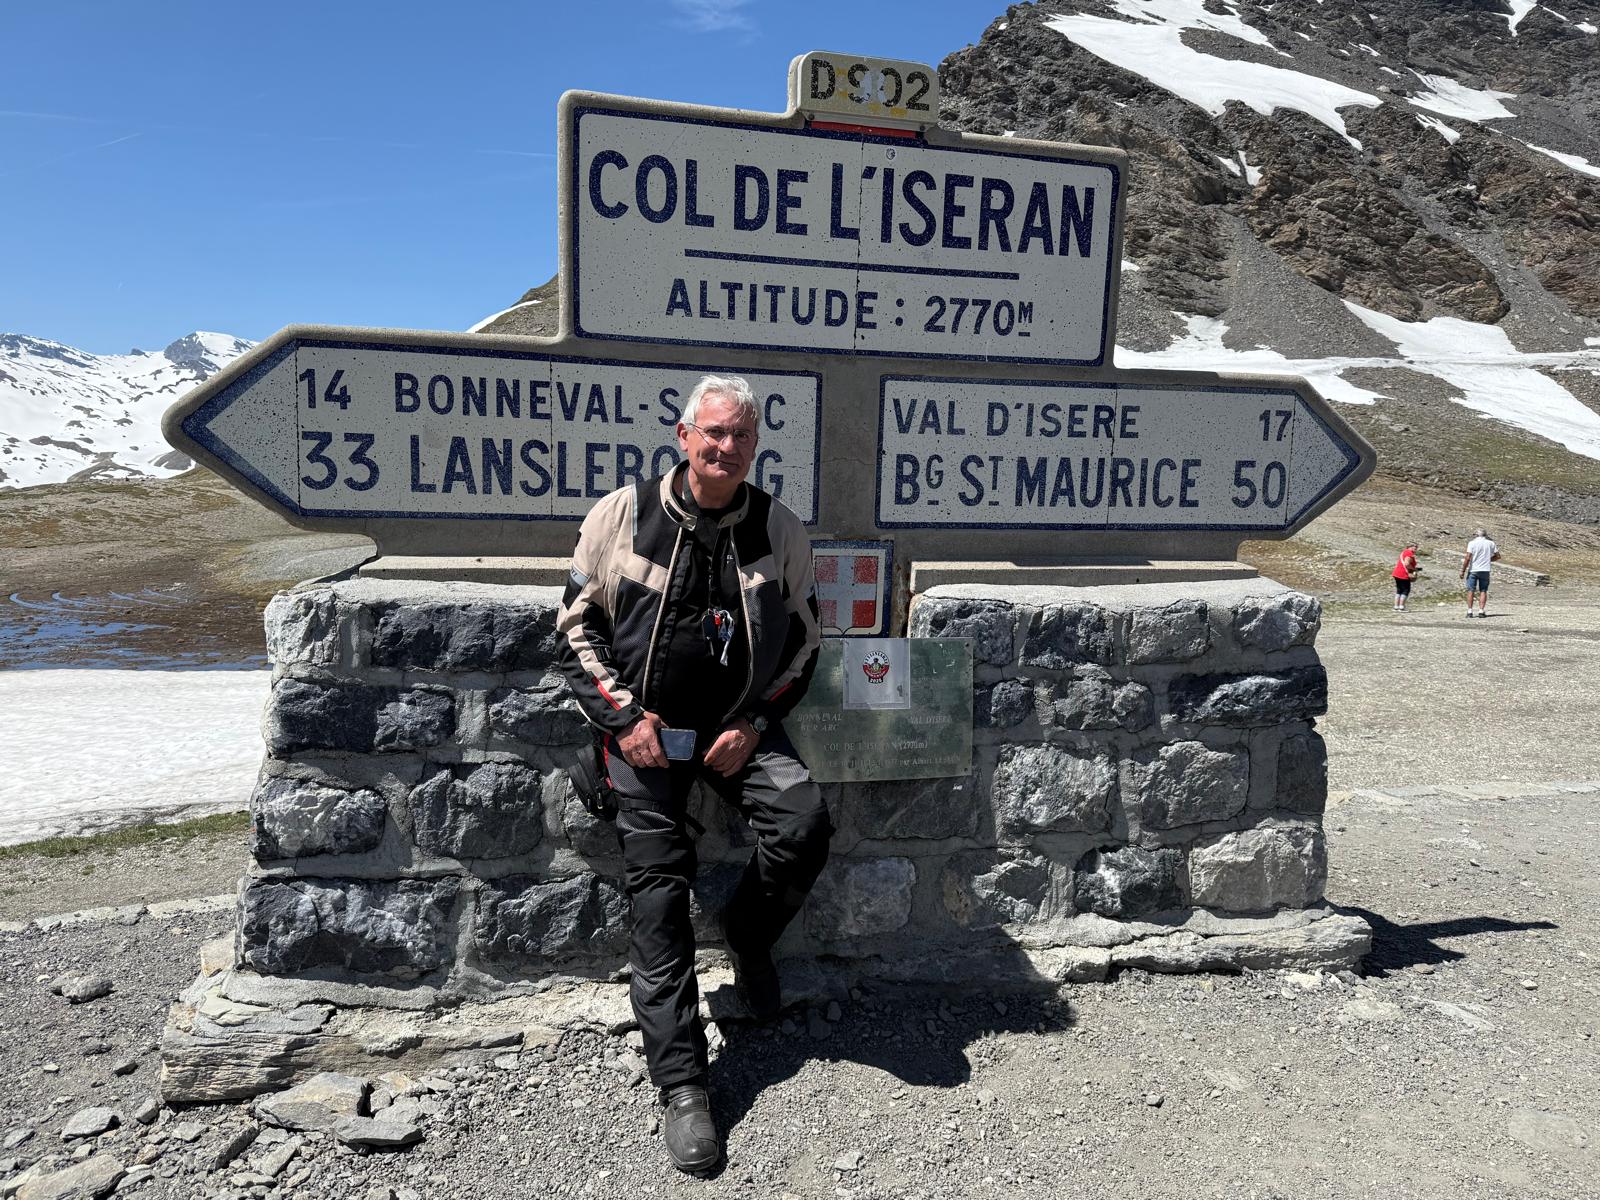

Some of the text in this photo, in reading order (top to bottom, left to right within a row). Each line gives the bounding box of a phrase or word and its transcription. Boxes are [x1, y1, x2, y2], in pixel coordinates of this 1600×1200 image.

[811, 59, 835, 99] D
[588, 150, 1095, 258] COL DE L'ISERAN
[665, 278, 878, 329] ALTITUDE
[299, 368, 351, 410] 14
[893, 398, 1292, 442] VAL D'ISERE 17
[301, 431, 380, 491] 33
[1015, 456, 1201, 508] MAURICE
[1231, 460, 1286, 509] 50
